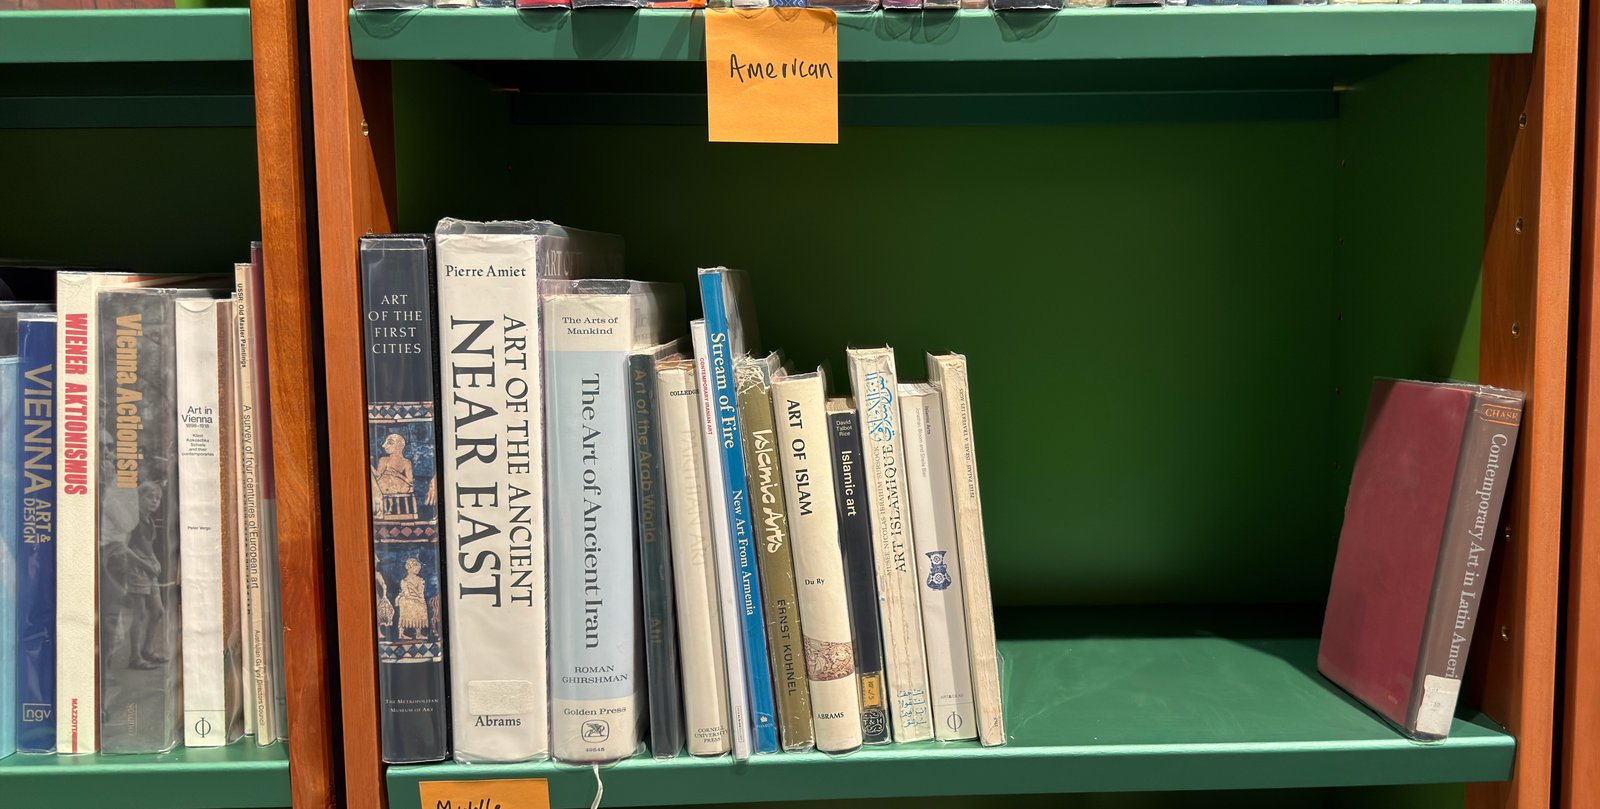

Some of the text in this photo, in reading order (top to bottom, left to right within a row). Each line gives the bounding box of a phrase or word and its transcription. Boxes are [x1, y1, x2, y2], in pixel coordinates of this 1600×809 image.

[730, 53, 833, 83] American
[446, 264, 526, 278] Pierre Amiet
[381, 294, 408, 305] ART
[368, 311, 422, 322] OF THE
[374, 327, 416, 338] FIRST
[372, 344, 422, 354] CITIES
[700, 358, 708, 401] CONTEMPORARY
[711, 332, 738, 449] Stream of Fire
[64, 313, 88, 496] WIENER AKTIONISMUS
[116, 313, 144, 489] Vienna Actionism
[187, 406, 213, 414] Art in
[1485, 408, 1518, 420] CHASE
[24, 364, 52, 494] VIENNA
[181, 414, 214, 424] Vienna
[243, 414, 252, 443] survey
[245, 447, 253, 456] of
[245, 457, 254, 474] four
[450, 314, 502, 607] NEAR EAST
[503, 314, 533, 606] ART OF THE ANCIENT
[634, 368, 656, 543] Art of the Arab World
[786, 399, 813, 516] ART OF ISLAM
[246, 478, 256, 518] centuries
[753, 429, 786, 554] Islamic Arts
[842, 450, 857, 517] Islamic art
[24, 499, 36, 544] DESIGN
[36, 499, 51, 543] ART &
[581, 373, 604, 649] The Art of Ancient Iran
[882, 444, 906, 572] ART ISLAMIQUE
[248, 520, 257, 530] of
[248, 532, 258, 574] European
[732, 490, 754, 616] New Art From Armenia
[1445, 434, 1508, 679] Contemporary Art in Latin Ameri
[251, 576, 260, 588] art
[816, 578, 825, 586] Ry
[778, 599, 790, 640] ERNST
[562, 674, 628, 684] GHIRSHMAN
[574, 665, 614, 674] ROMAN
[26, 708, 52, 721] ngv
[475, 715, 522, 727] Abrams
[564, 706, 627, 716] Golden Press
[817, 712, 844, 720] ABRAMS
[694, 730, 728, 738] UNIVERSITY
